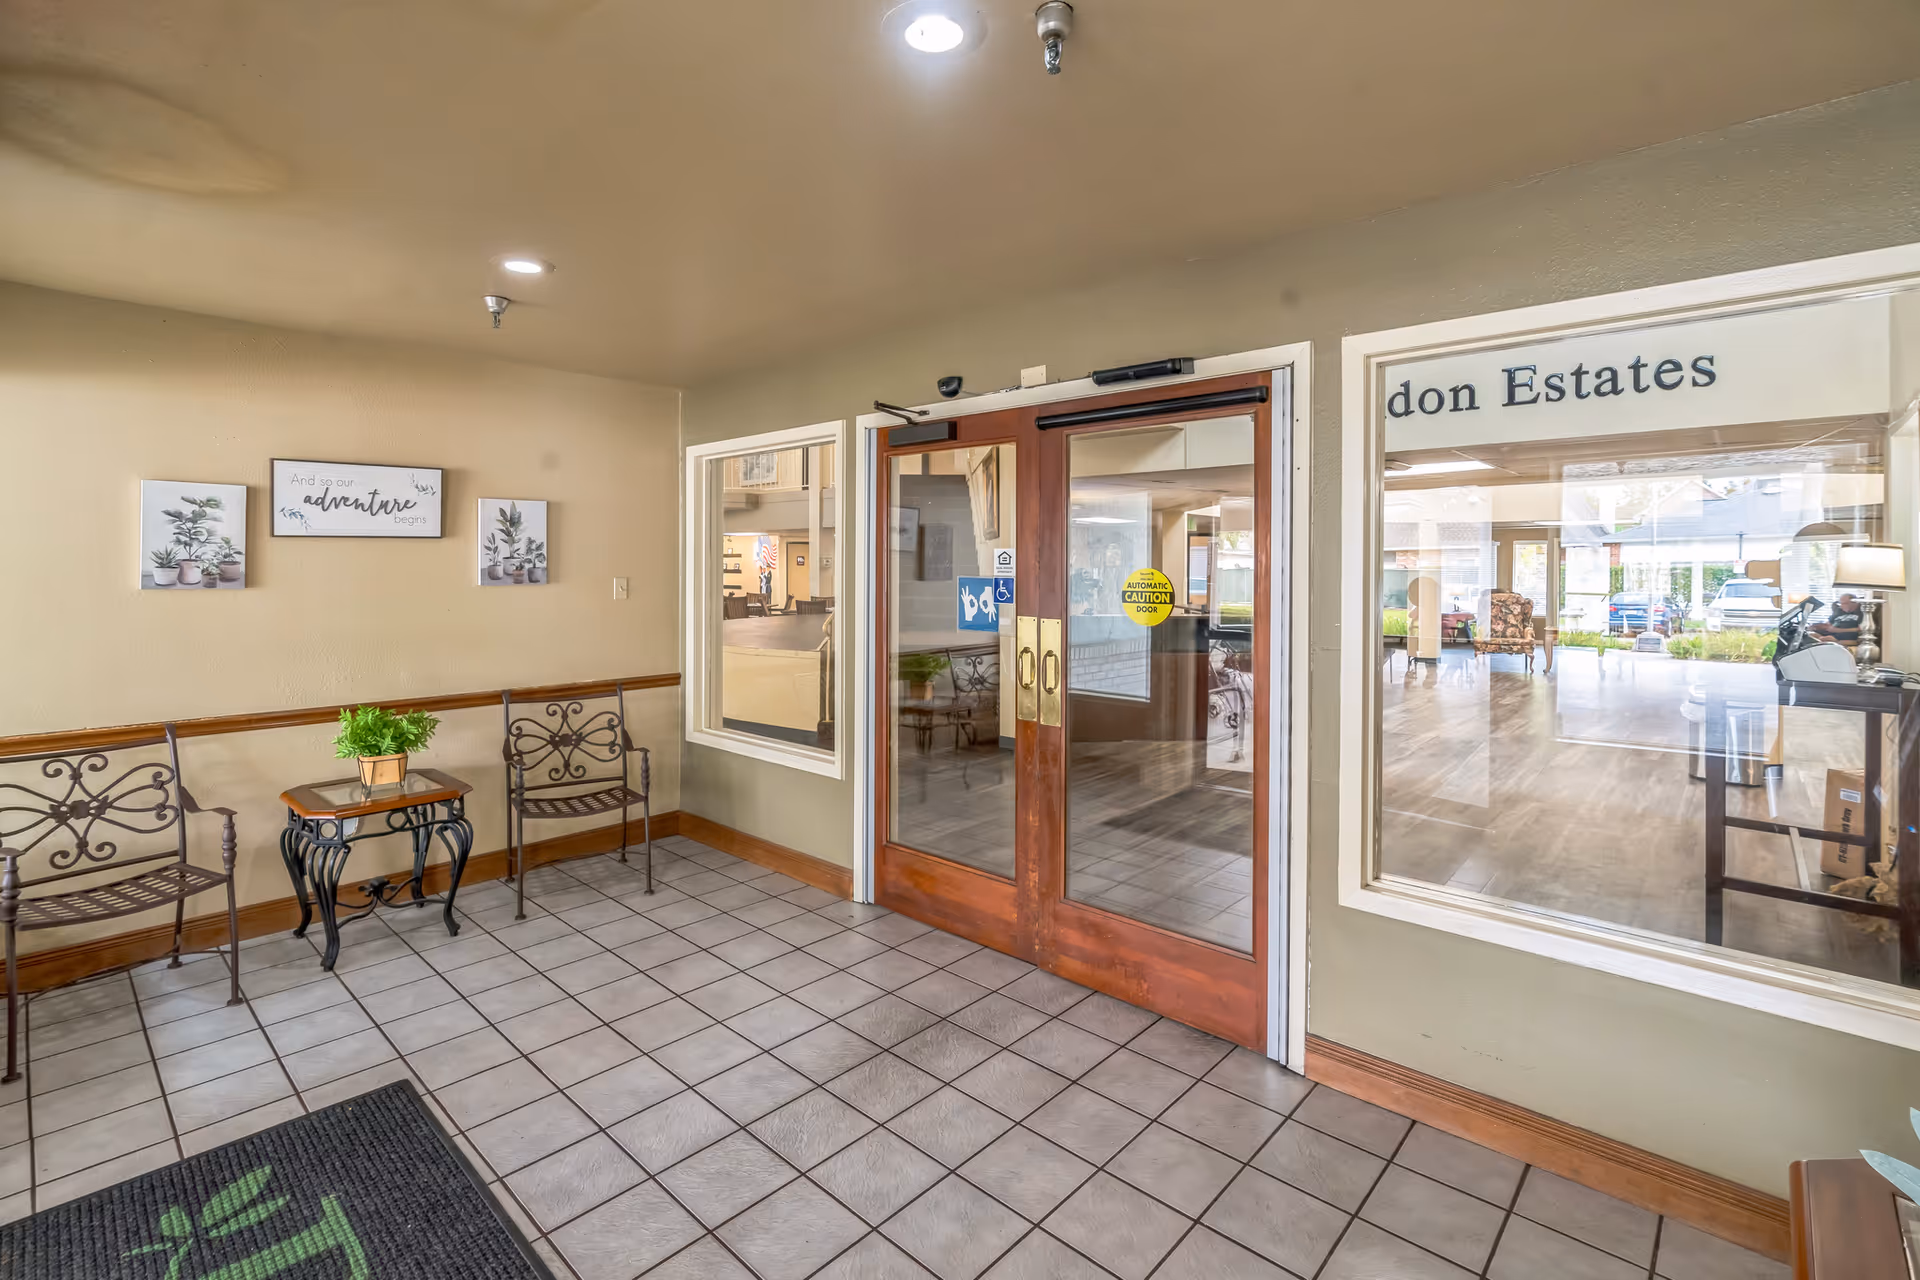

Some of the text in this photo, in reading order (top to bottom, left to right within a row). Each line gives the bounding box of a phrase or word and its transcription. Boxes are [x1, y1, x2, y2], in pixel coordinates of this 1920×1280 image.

[1387, 353, 1717, 418] don Estates
[290, 473, 354, 488] And so our
[303, 486, 417, 516] adventure
[394, 513, 427, 526] begins
[1126, 581, 1168, 590] AUTOMATIC
[1124, 591, 1170, 603] CAUTION
[1136, 605, 1158, 614] DOOR
